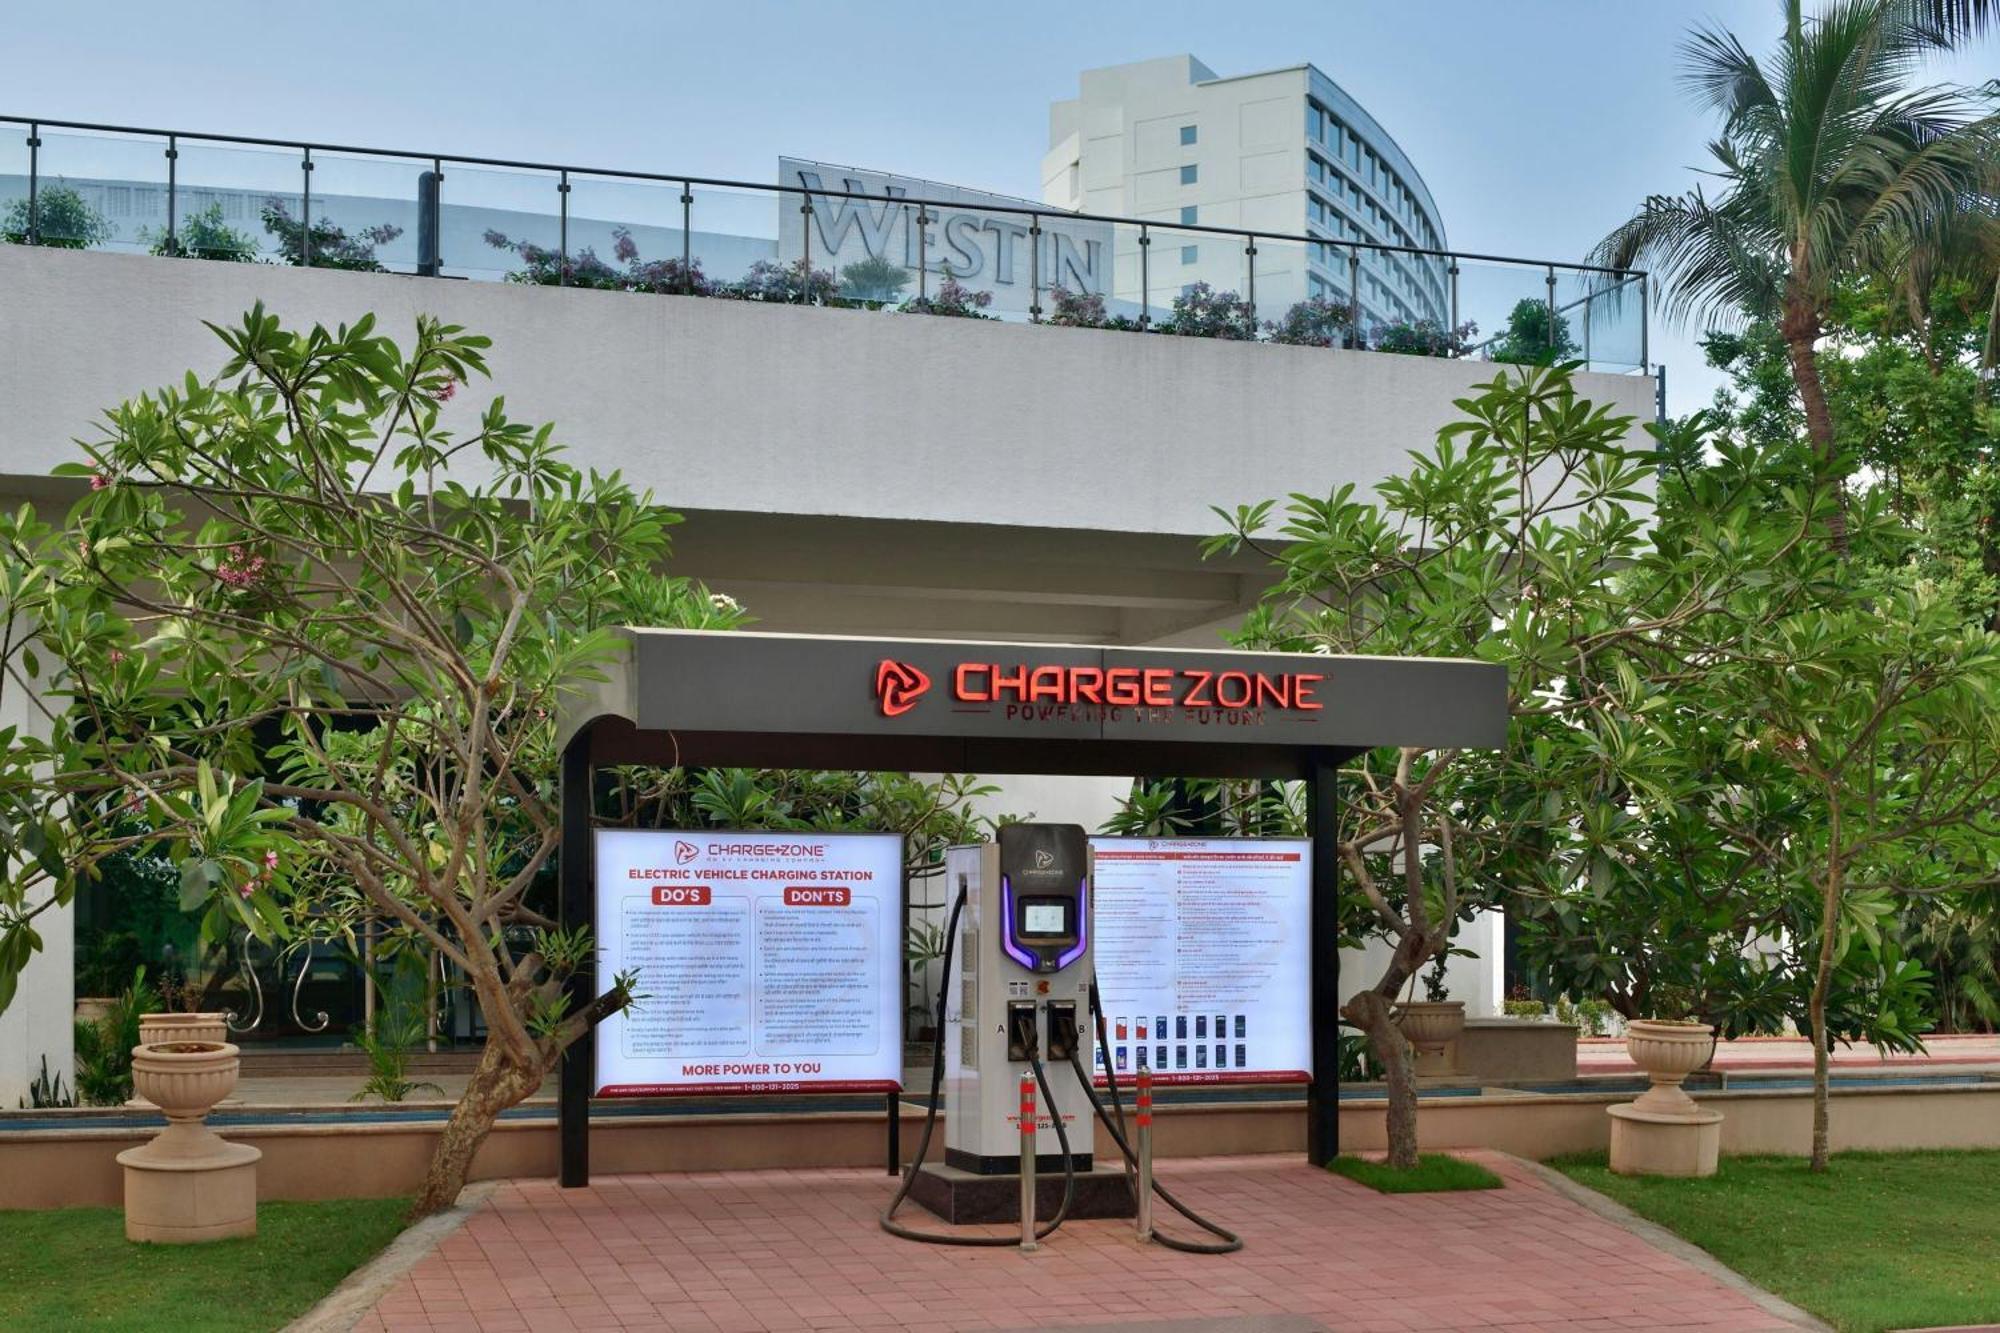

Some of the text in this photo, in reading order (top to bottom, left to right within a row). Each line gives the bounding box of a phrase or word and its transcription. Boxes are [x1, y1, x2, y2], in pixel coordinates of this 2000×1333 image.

[797, 170, 1101, 294] WESTIN
[629, 869, 873, 881] ELECTRIC VEHICLE CHARGING STATION
[660, 888, 701, 903] DO'S
[790, 890, 844, 904] DON'TS
[997, 1025, 1005, 1033] A
[1079, 1024, 1085, 1033] B
[682, 1063, 821, 1076] MORE POWER TO YOU
